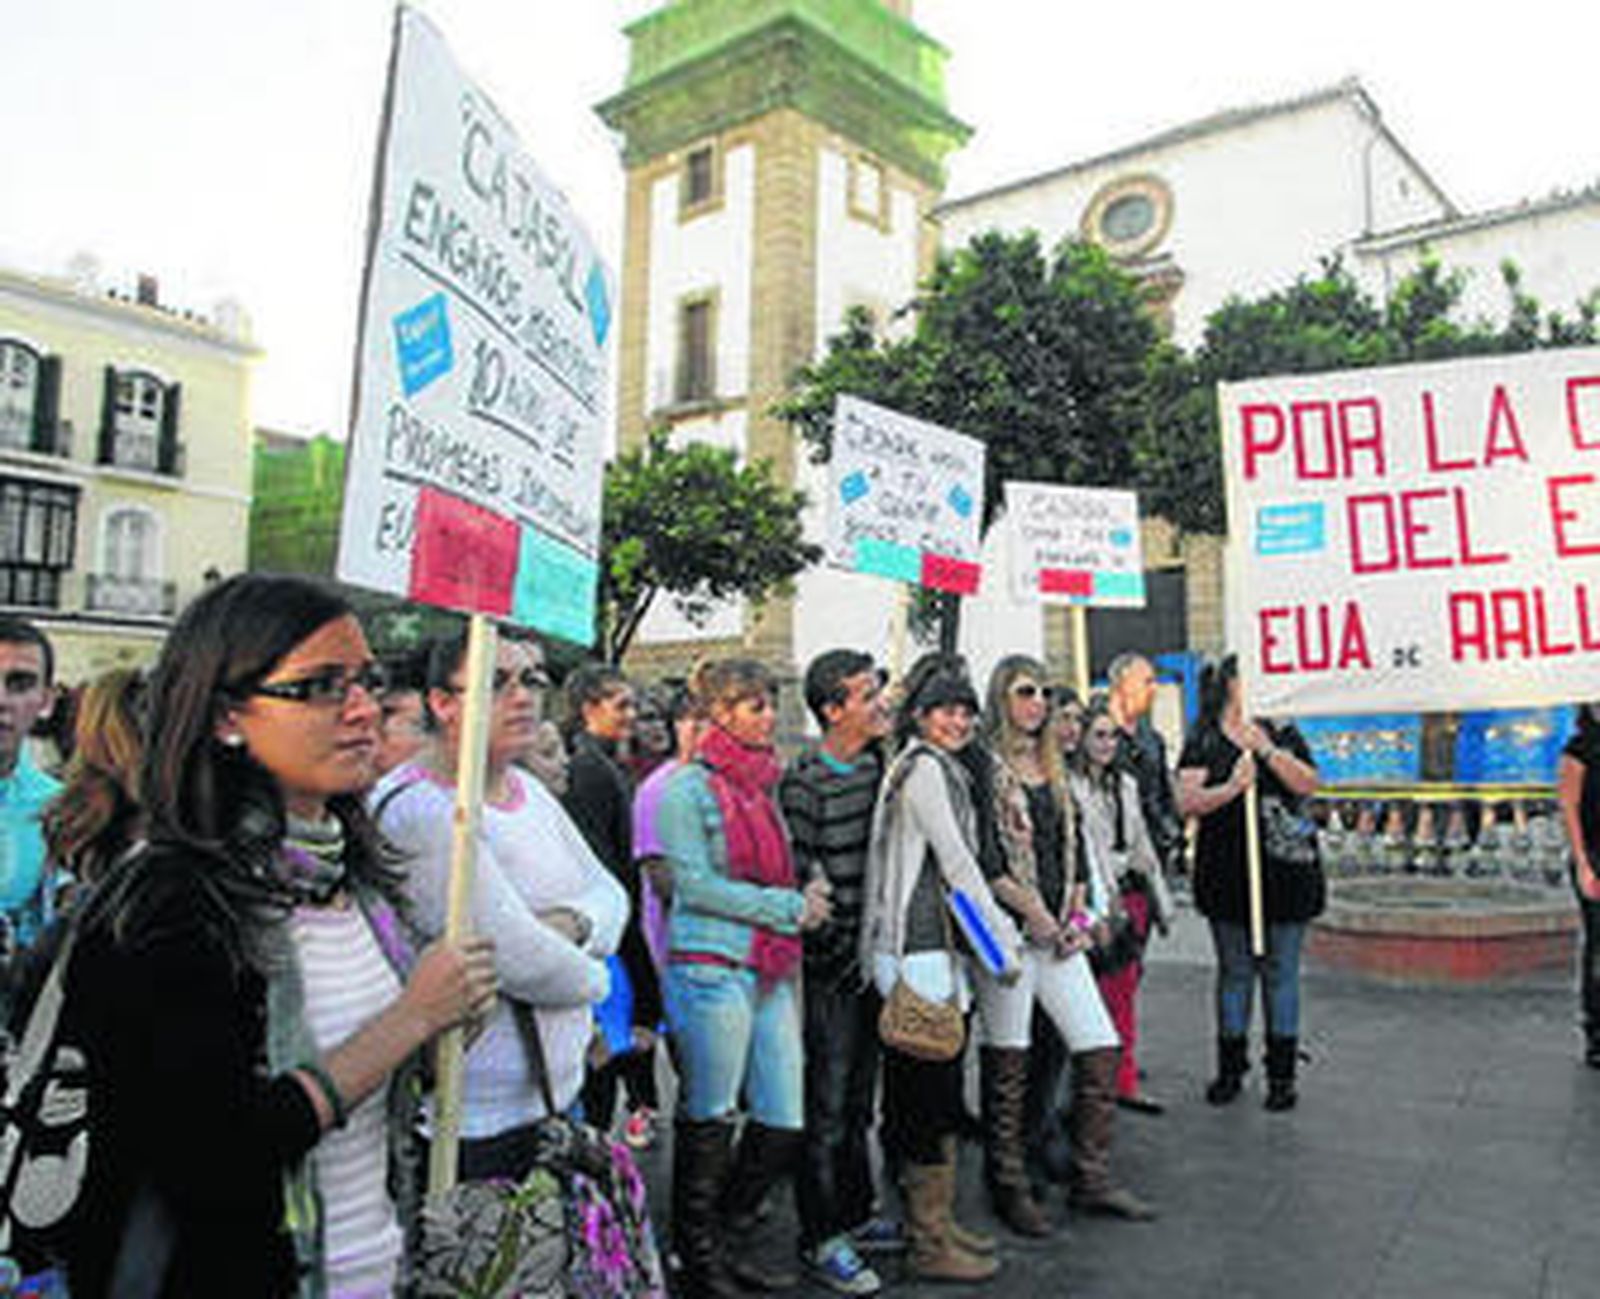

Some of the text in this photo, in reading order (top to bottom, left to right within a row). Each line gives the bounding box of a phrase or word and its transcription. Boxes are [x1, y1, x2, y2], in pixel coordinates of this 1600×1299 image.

[1240, 394, 1387, 481] POR
[1421, 382, 1529, 474] LA
[1345, 485, 1511, 576] DEL
[1258, 599, 1373, 675] EUA
